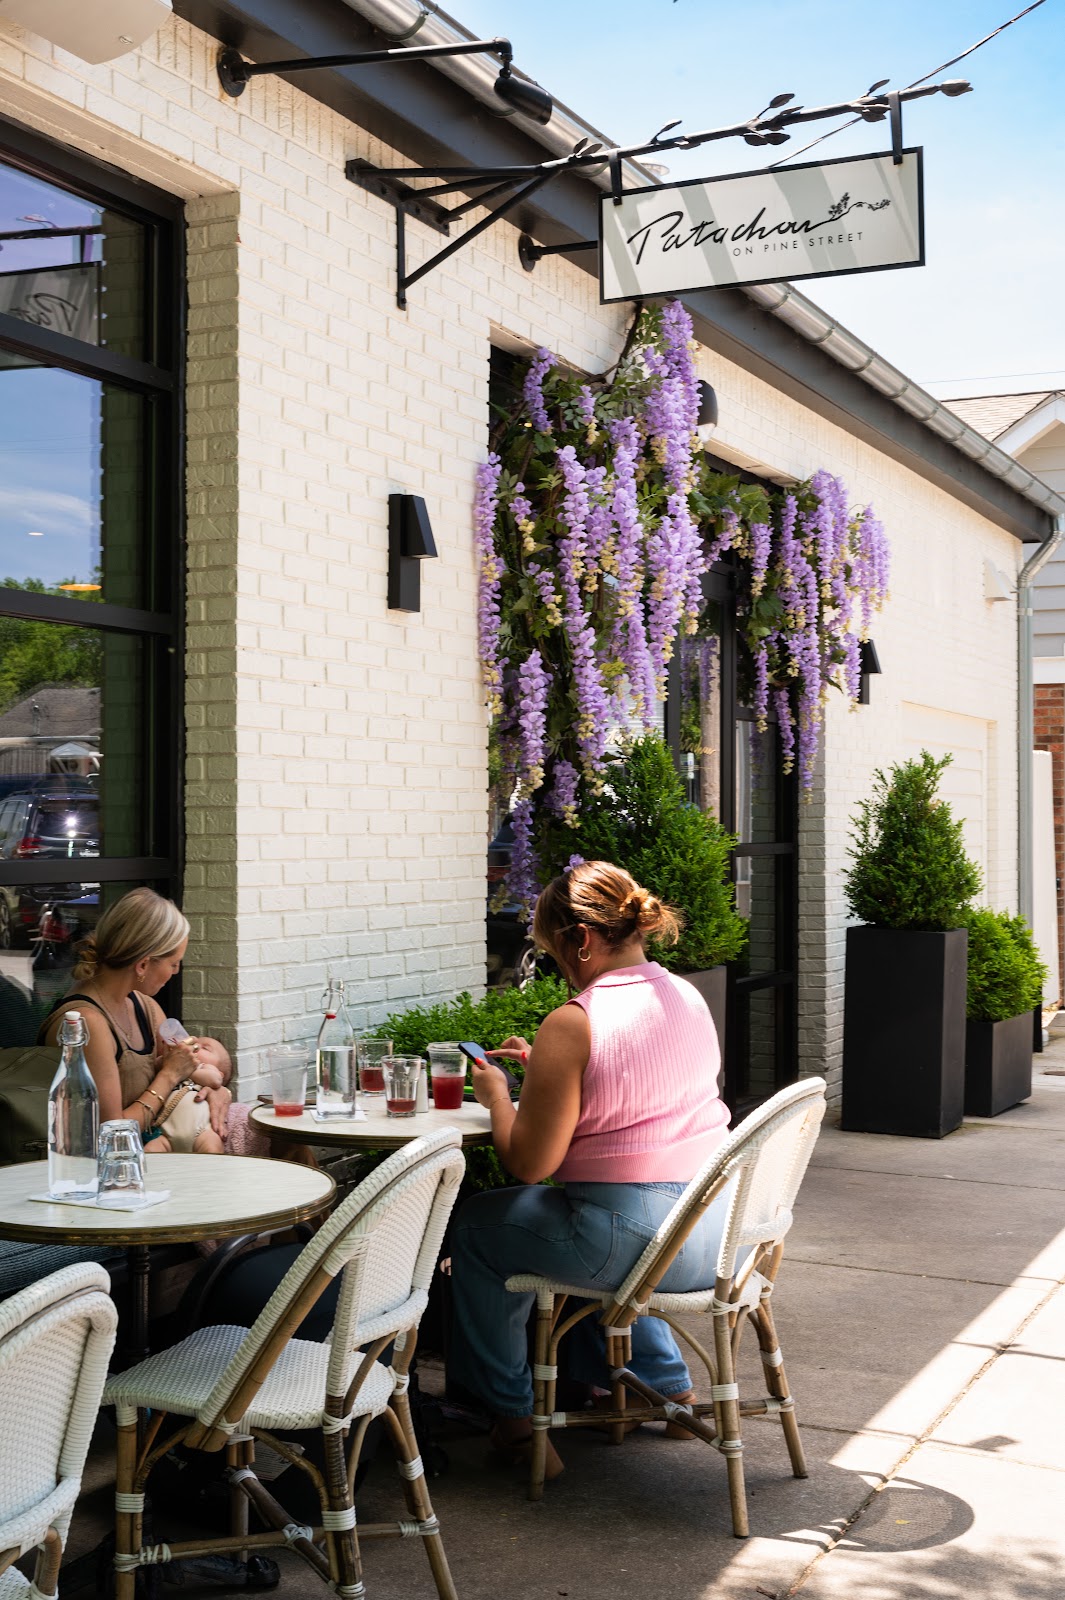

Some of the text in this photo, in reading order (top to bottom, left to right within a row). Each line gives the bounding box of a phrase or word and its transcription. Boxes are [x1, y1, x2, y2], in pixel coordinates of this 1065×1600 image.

[626, 206, 834, 265] Patachou
[732, 231, 864, 257] ON PINE STREET
